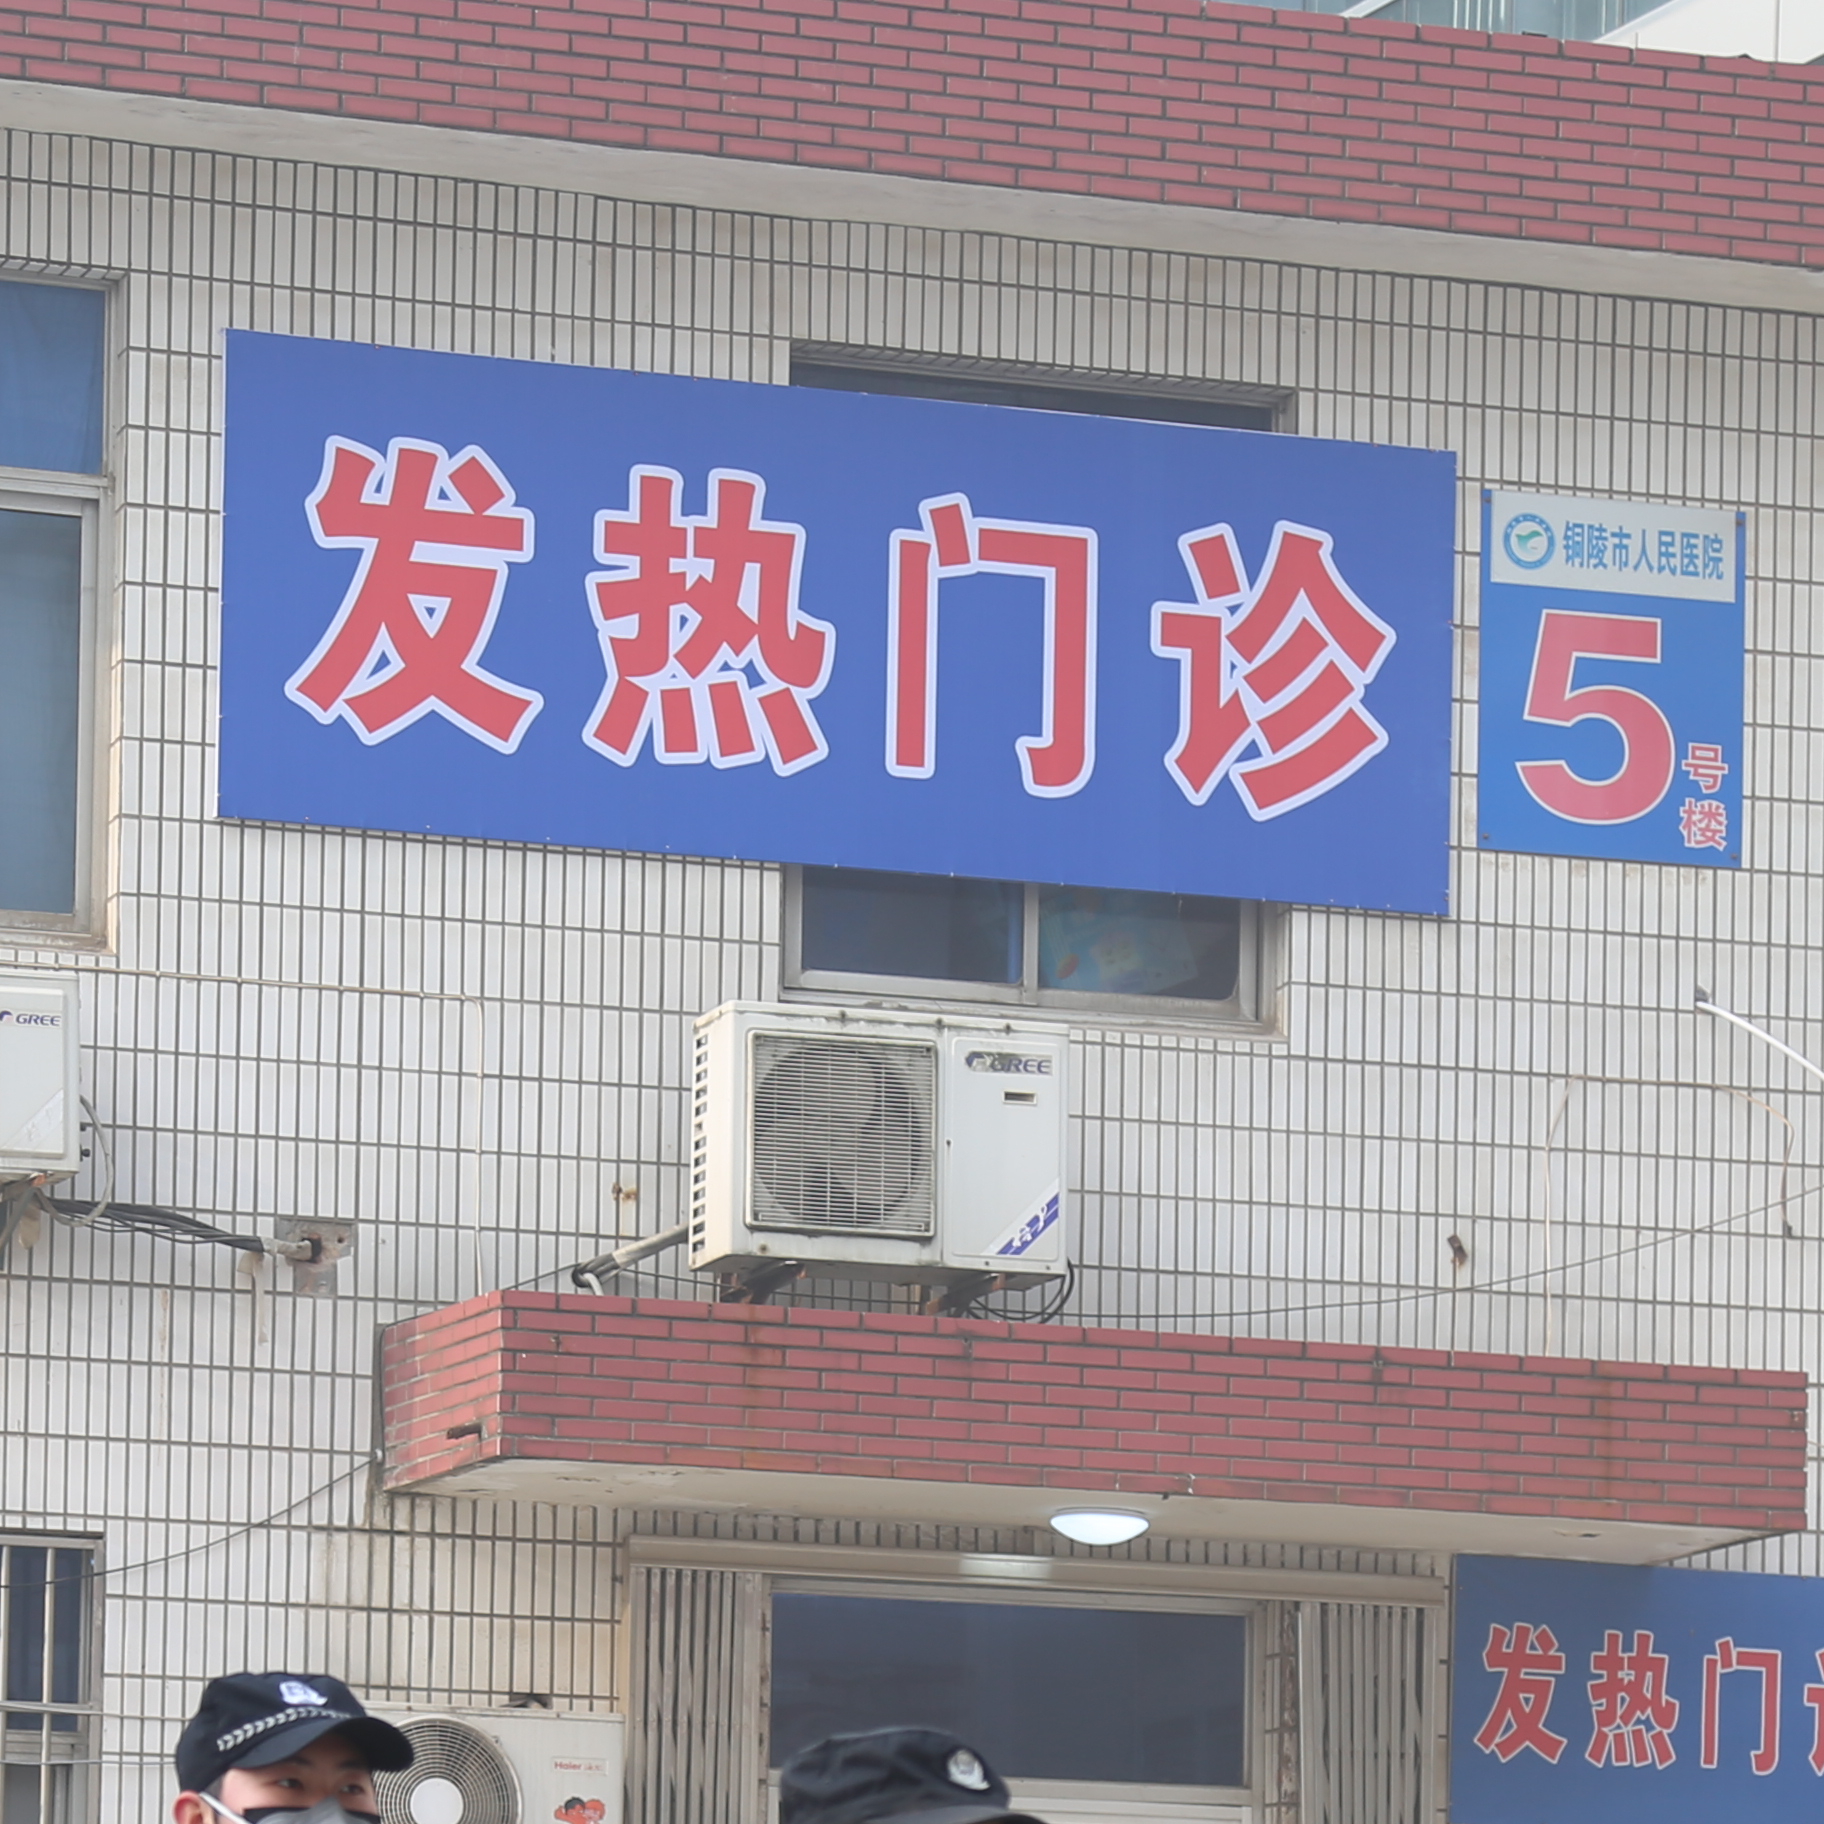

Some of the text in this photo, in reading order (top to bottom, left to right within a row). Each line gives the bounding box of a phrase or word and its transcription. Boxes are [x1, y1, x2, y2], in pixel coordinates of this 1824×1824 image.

[1563, 521, 1724, 580] 铜陵市人民医院
[284, 434, 1395, 821] 发热门诊
[1515, 609, 1728, 851] 5 号楼
[16, 1013, 61, 1026] GREE
